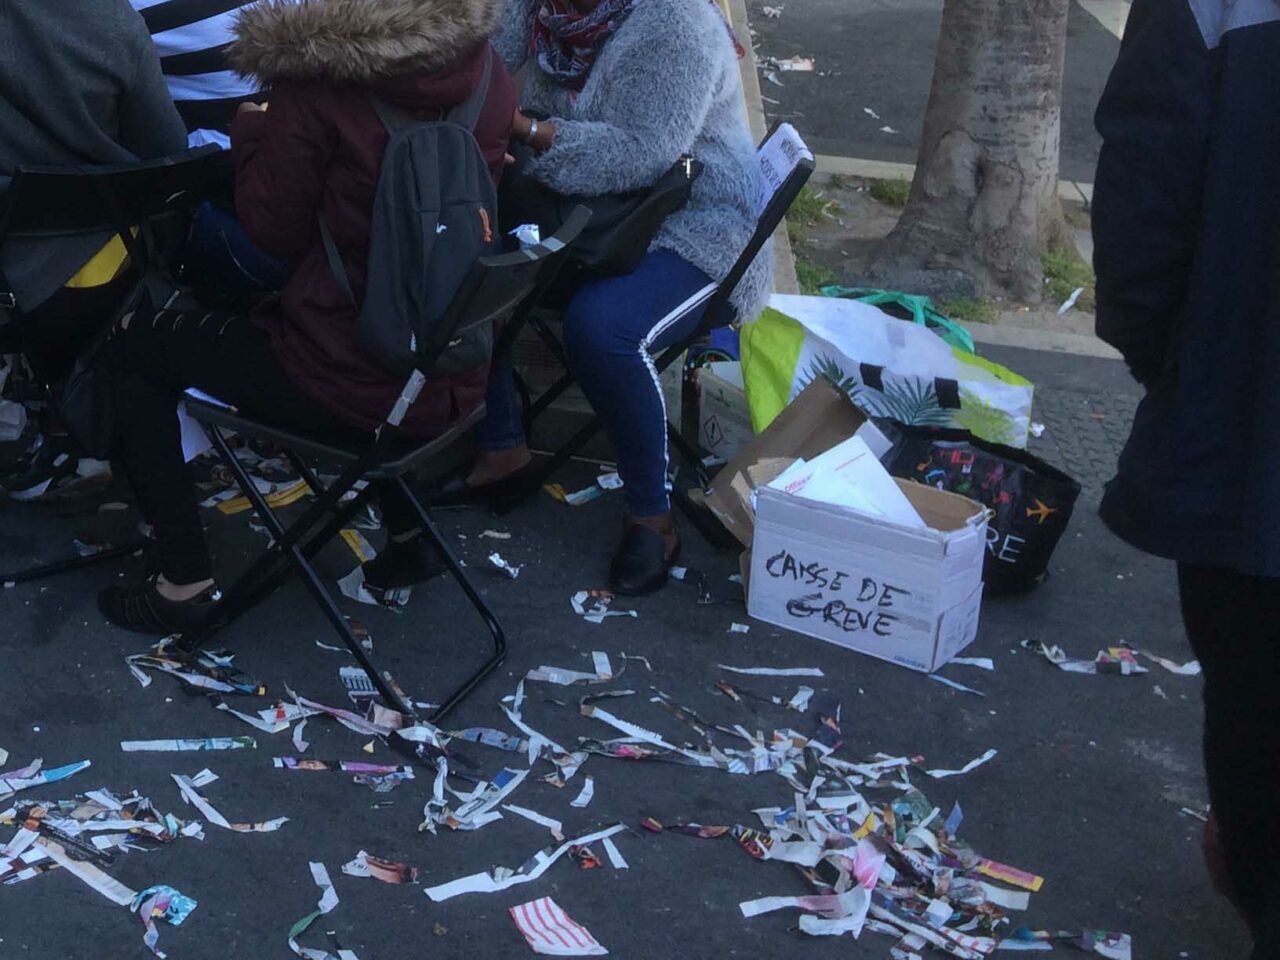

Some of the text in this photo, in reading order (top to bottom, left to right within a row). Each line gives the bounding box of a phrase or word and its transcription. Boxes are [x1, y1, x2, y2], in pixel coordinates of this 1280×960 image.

[765, 549, 912, 608] CAISSE DE
[785, 592, 902, 637] GREVE
